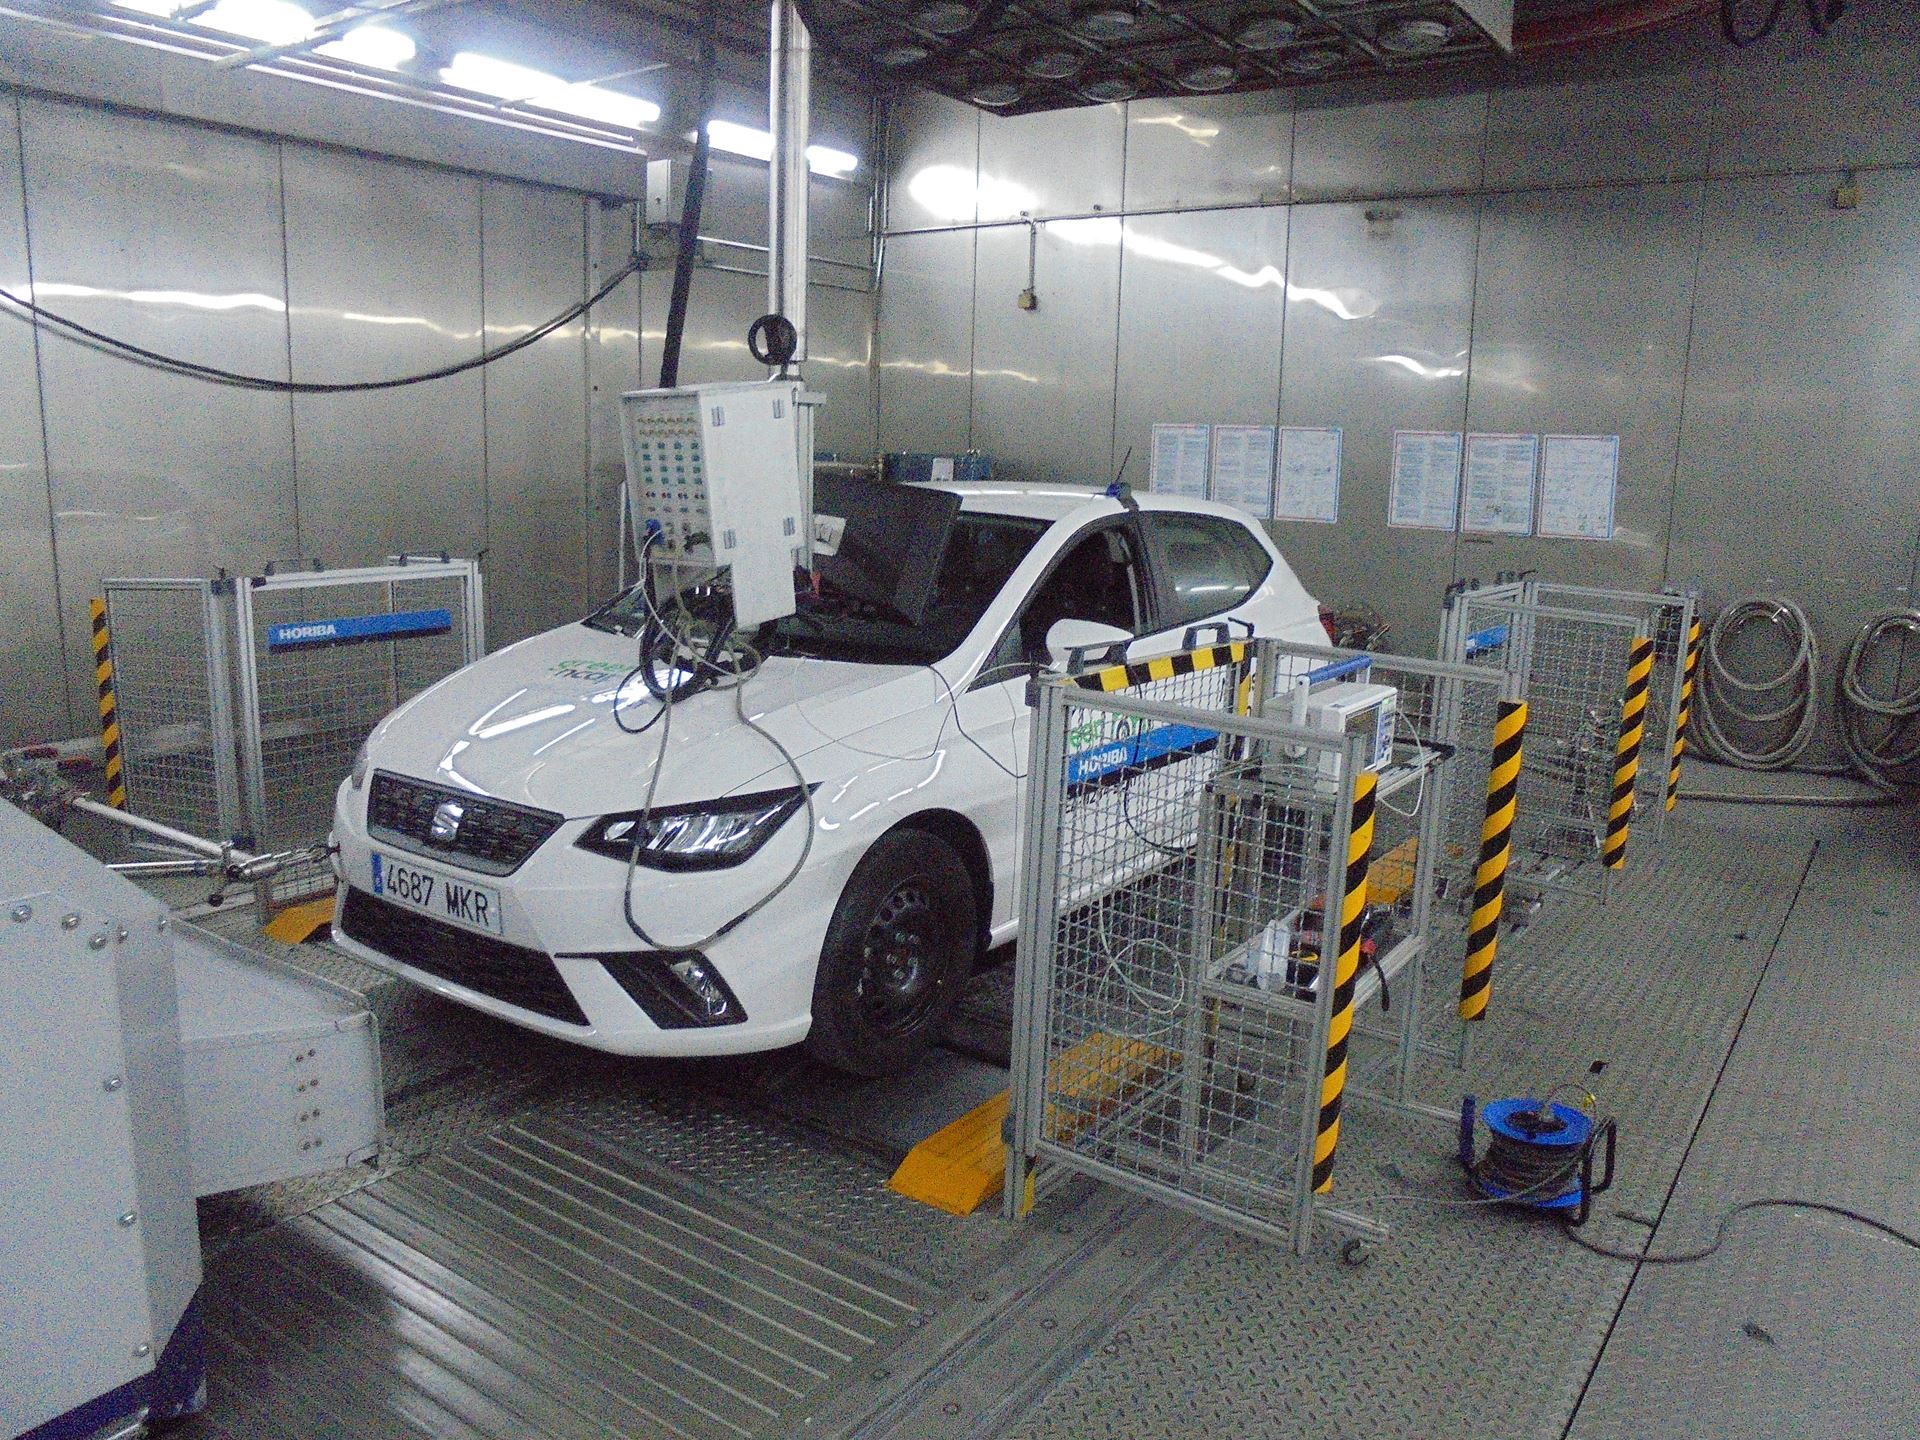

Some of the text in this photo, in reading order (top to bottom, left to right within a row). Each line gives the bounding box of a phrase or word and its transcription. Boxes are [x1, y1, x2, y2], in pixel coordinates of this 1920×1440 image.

[279, 624, 336, 641] HORIBA
[1079, 746, 1128, 776] HORIBA
[387, 863, 489, 927] 4687 MKR
